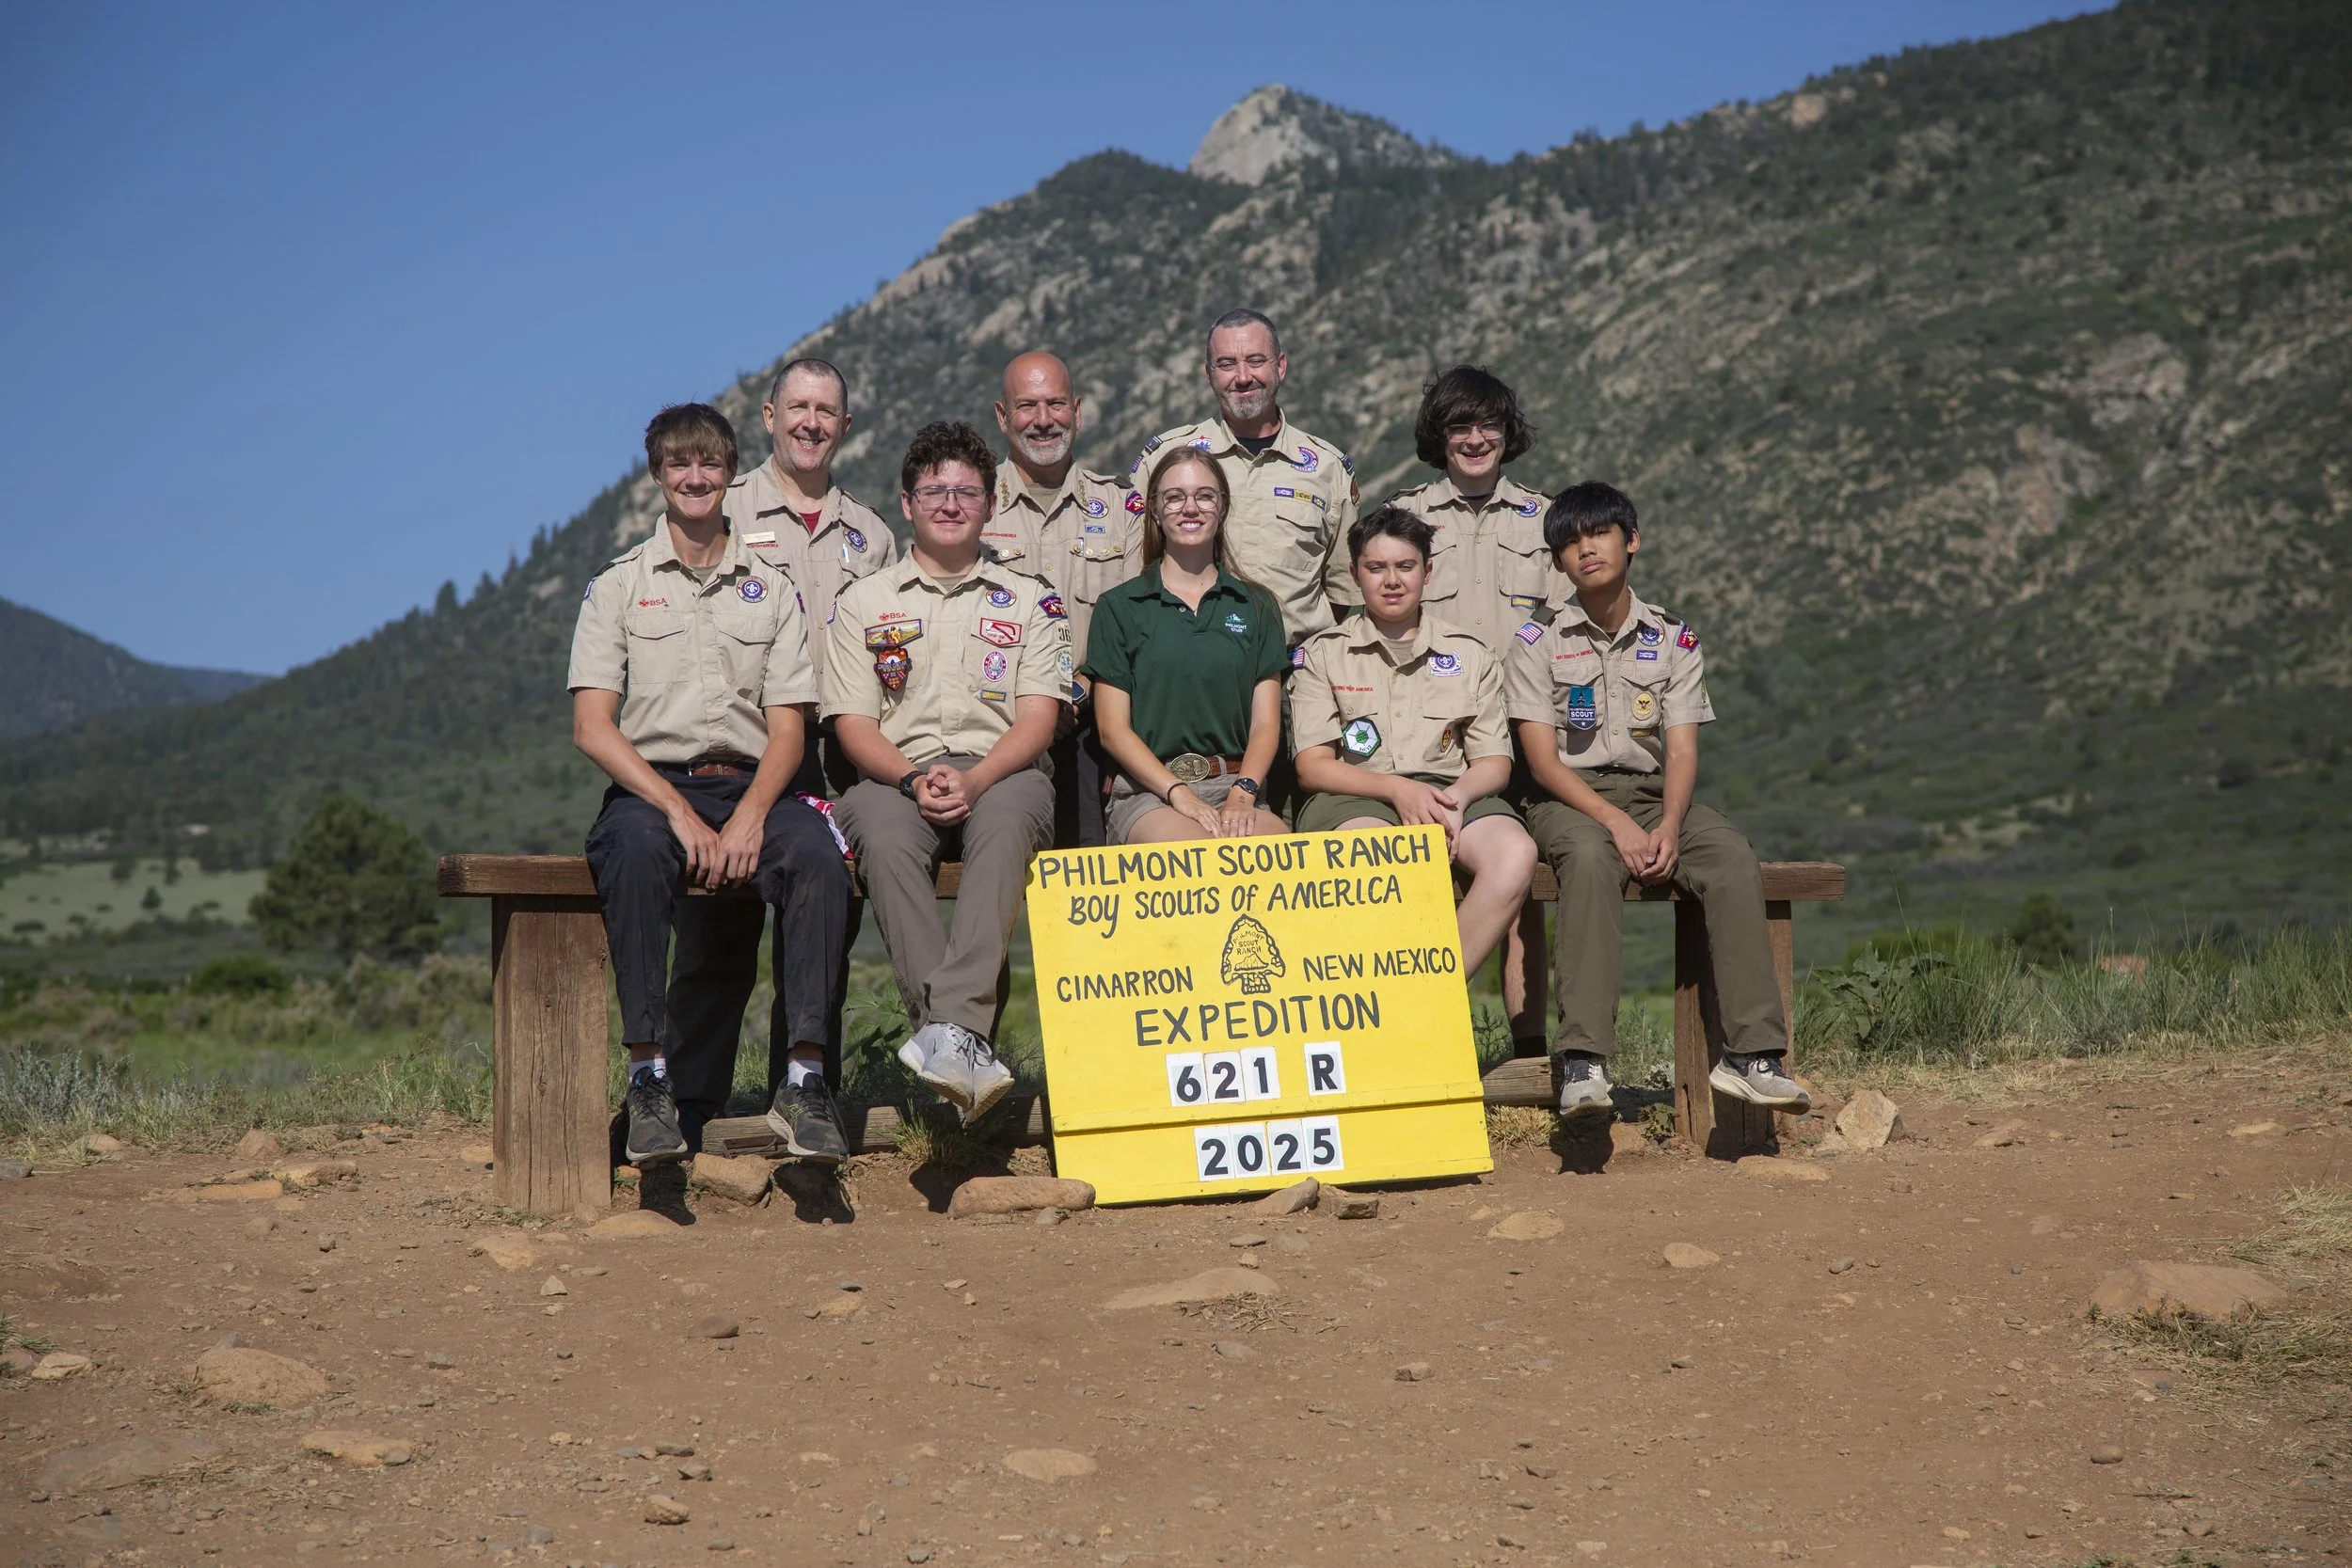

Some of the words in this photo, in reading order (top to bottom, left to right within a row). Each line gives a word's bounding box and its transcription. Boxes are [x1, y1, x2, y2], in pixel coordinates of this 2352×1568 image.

[649, 597, 667, 607] BSA
[1225, 622, 1248, 630] PHILMONT
[1039, 847, 1206, 889] PHILMONT
[1217, 840, 1311, 877] SCOUT
[1325, 833, 1431, 869] RANCH
[1068, 895, 1120, 940] BOY
[1135, 886, 1220, 920] SCOUTS
[1267, 874, 1403, 911] AMERICA
[1236, 945, 1262, 955] RANCH
[1238, 940, 1259, 948] SCOUT
[1057, 965, 1194, 1003] CIMARRON
[1303, 954, 1364, 981] NEW
[1374, 946, 1456, 975] MEXICO
[1135, 991, 1380, 1047] EXPEDITION
[1176, 1056, 1270, 1102] 621
[1311, 1053, 1339, 1091] R
[1200, 1127, 1336, 1177] 2025
